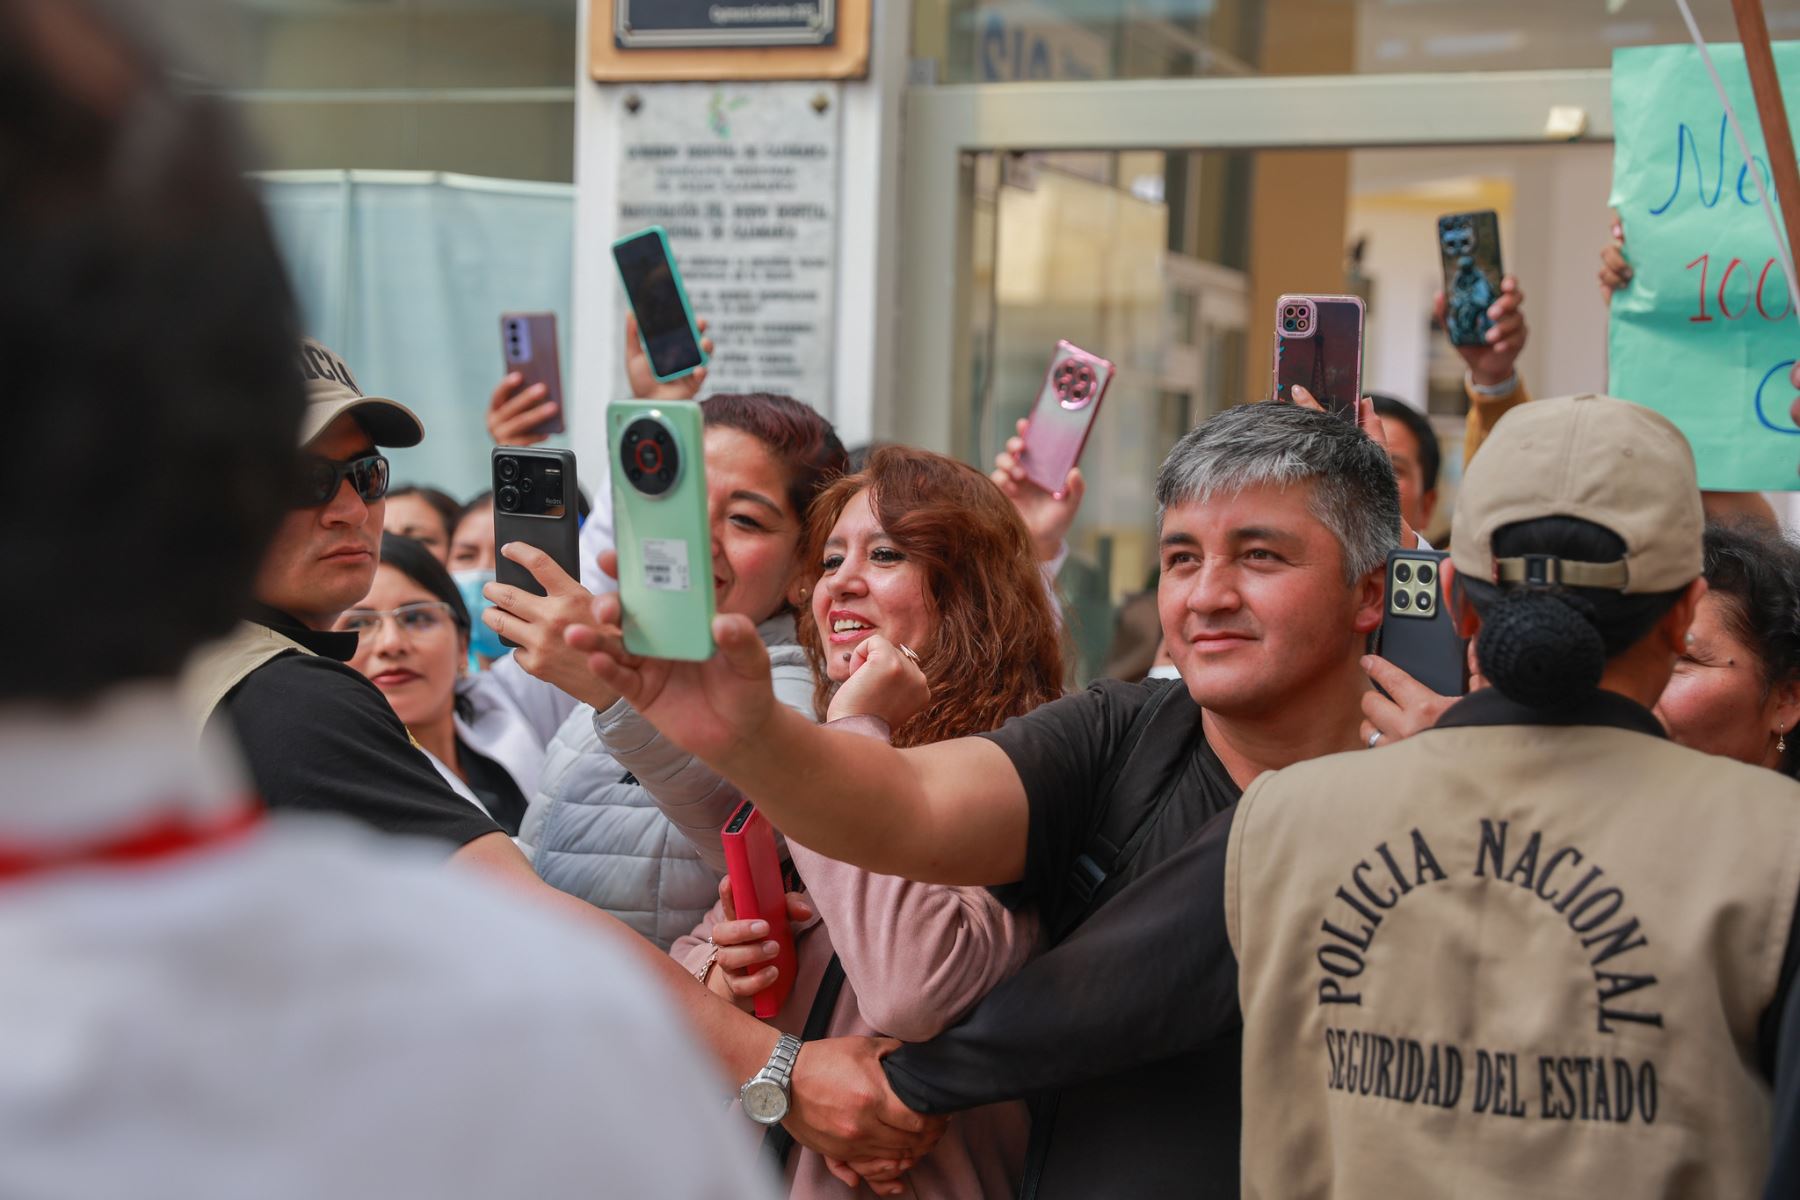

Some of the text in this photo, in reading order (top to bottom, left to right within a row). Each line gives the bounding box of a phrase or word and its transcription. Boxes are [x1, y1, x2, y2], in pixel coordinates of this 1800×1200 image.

[1650, 109, 1780, 215] No
[1316, 818, 1664, 1034] POLICIA NACIONAL
[1325, 1027, 1658, 1125] SEGURIDAD DEL ESTADO
